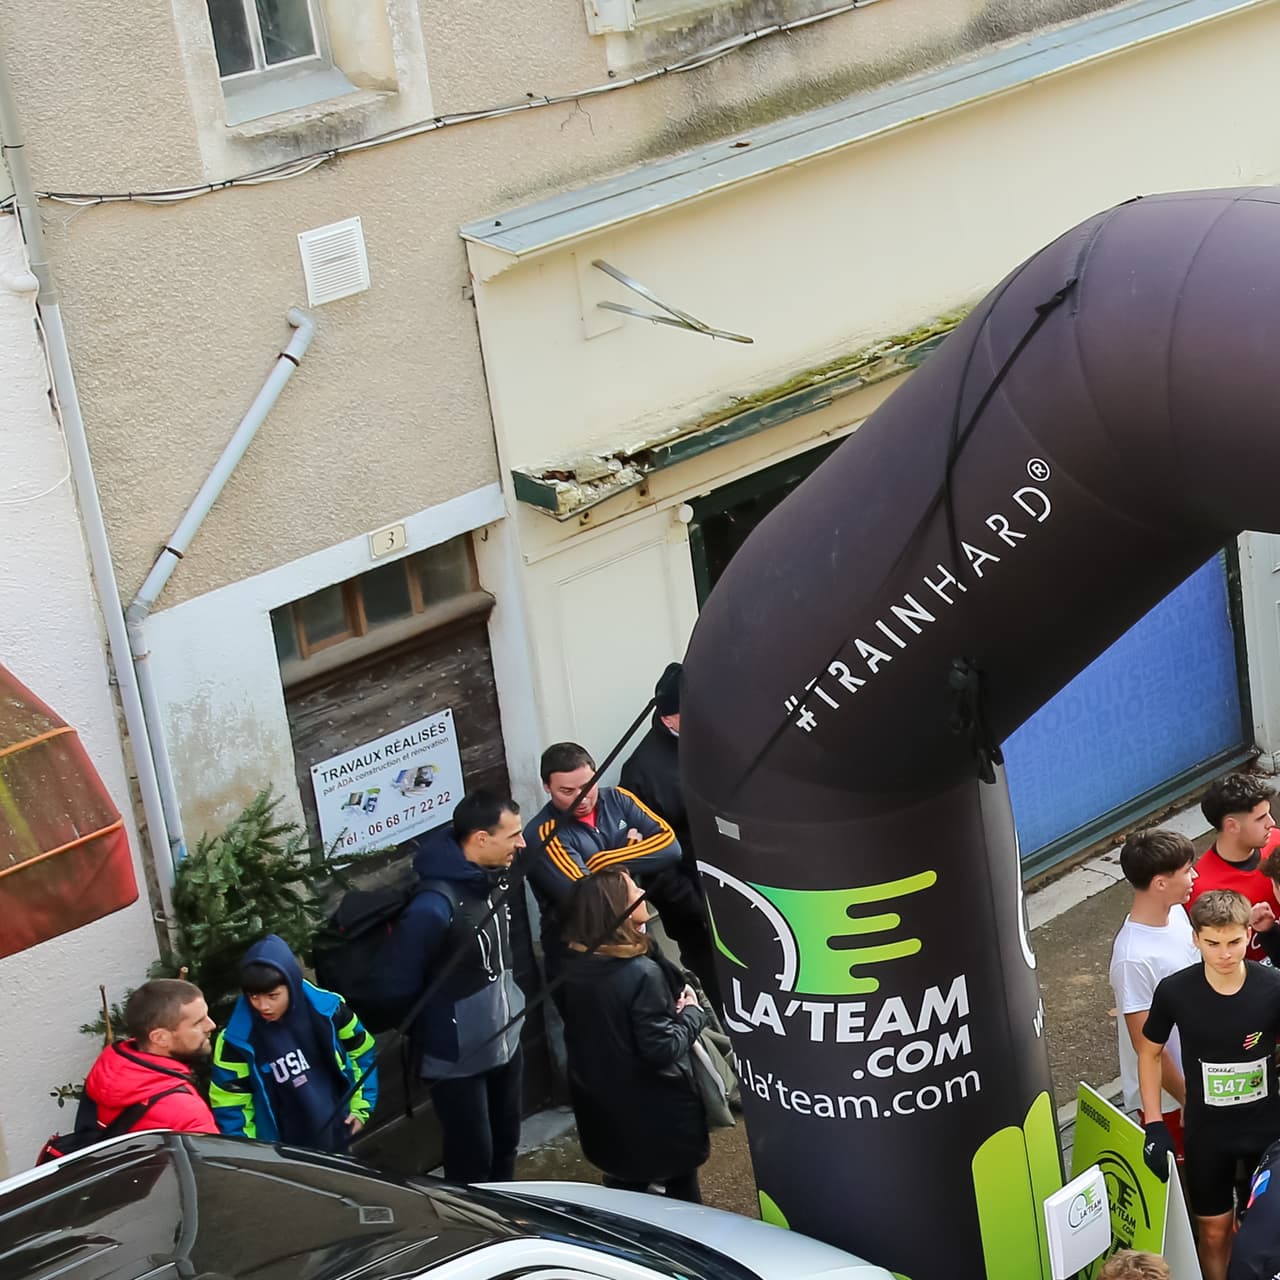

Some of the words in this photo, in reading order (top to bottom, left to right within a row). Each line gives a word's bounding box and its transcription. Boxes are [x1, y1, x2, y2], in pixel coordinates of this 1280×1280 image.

[386, 531, 394, 550] 3
[321, 751, 382, 783] TRAVAUX
[384, 722, 447, 758] RÉALISÉS
[322, 783, 335, 797] par
[336, 776, 353, 790] ADA
[354, 759, 401, 784] construction
[368, 821, 383, 835] 06
[386, 814, 400, 829] 68
[403, 806, 417, 820] 77
[420, 799, 434, 813] 22
[437, 791, 451, 806] 22
[732, 975, 969, 1043] LA'TEAM
[269, 1049, 310, 1083] USA
[853, 1024, 972, 1080] .COM
[1213, 1079, 1246, 1094] 547
